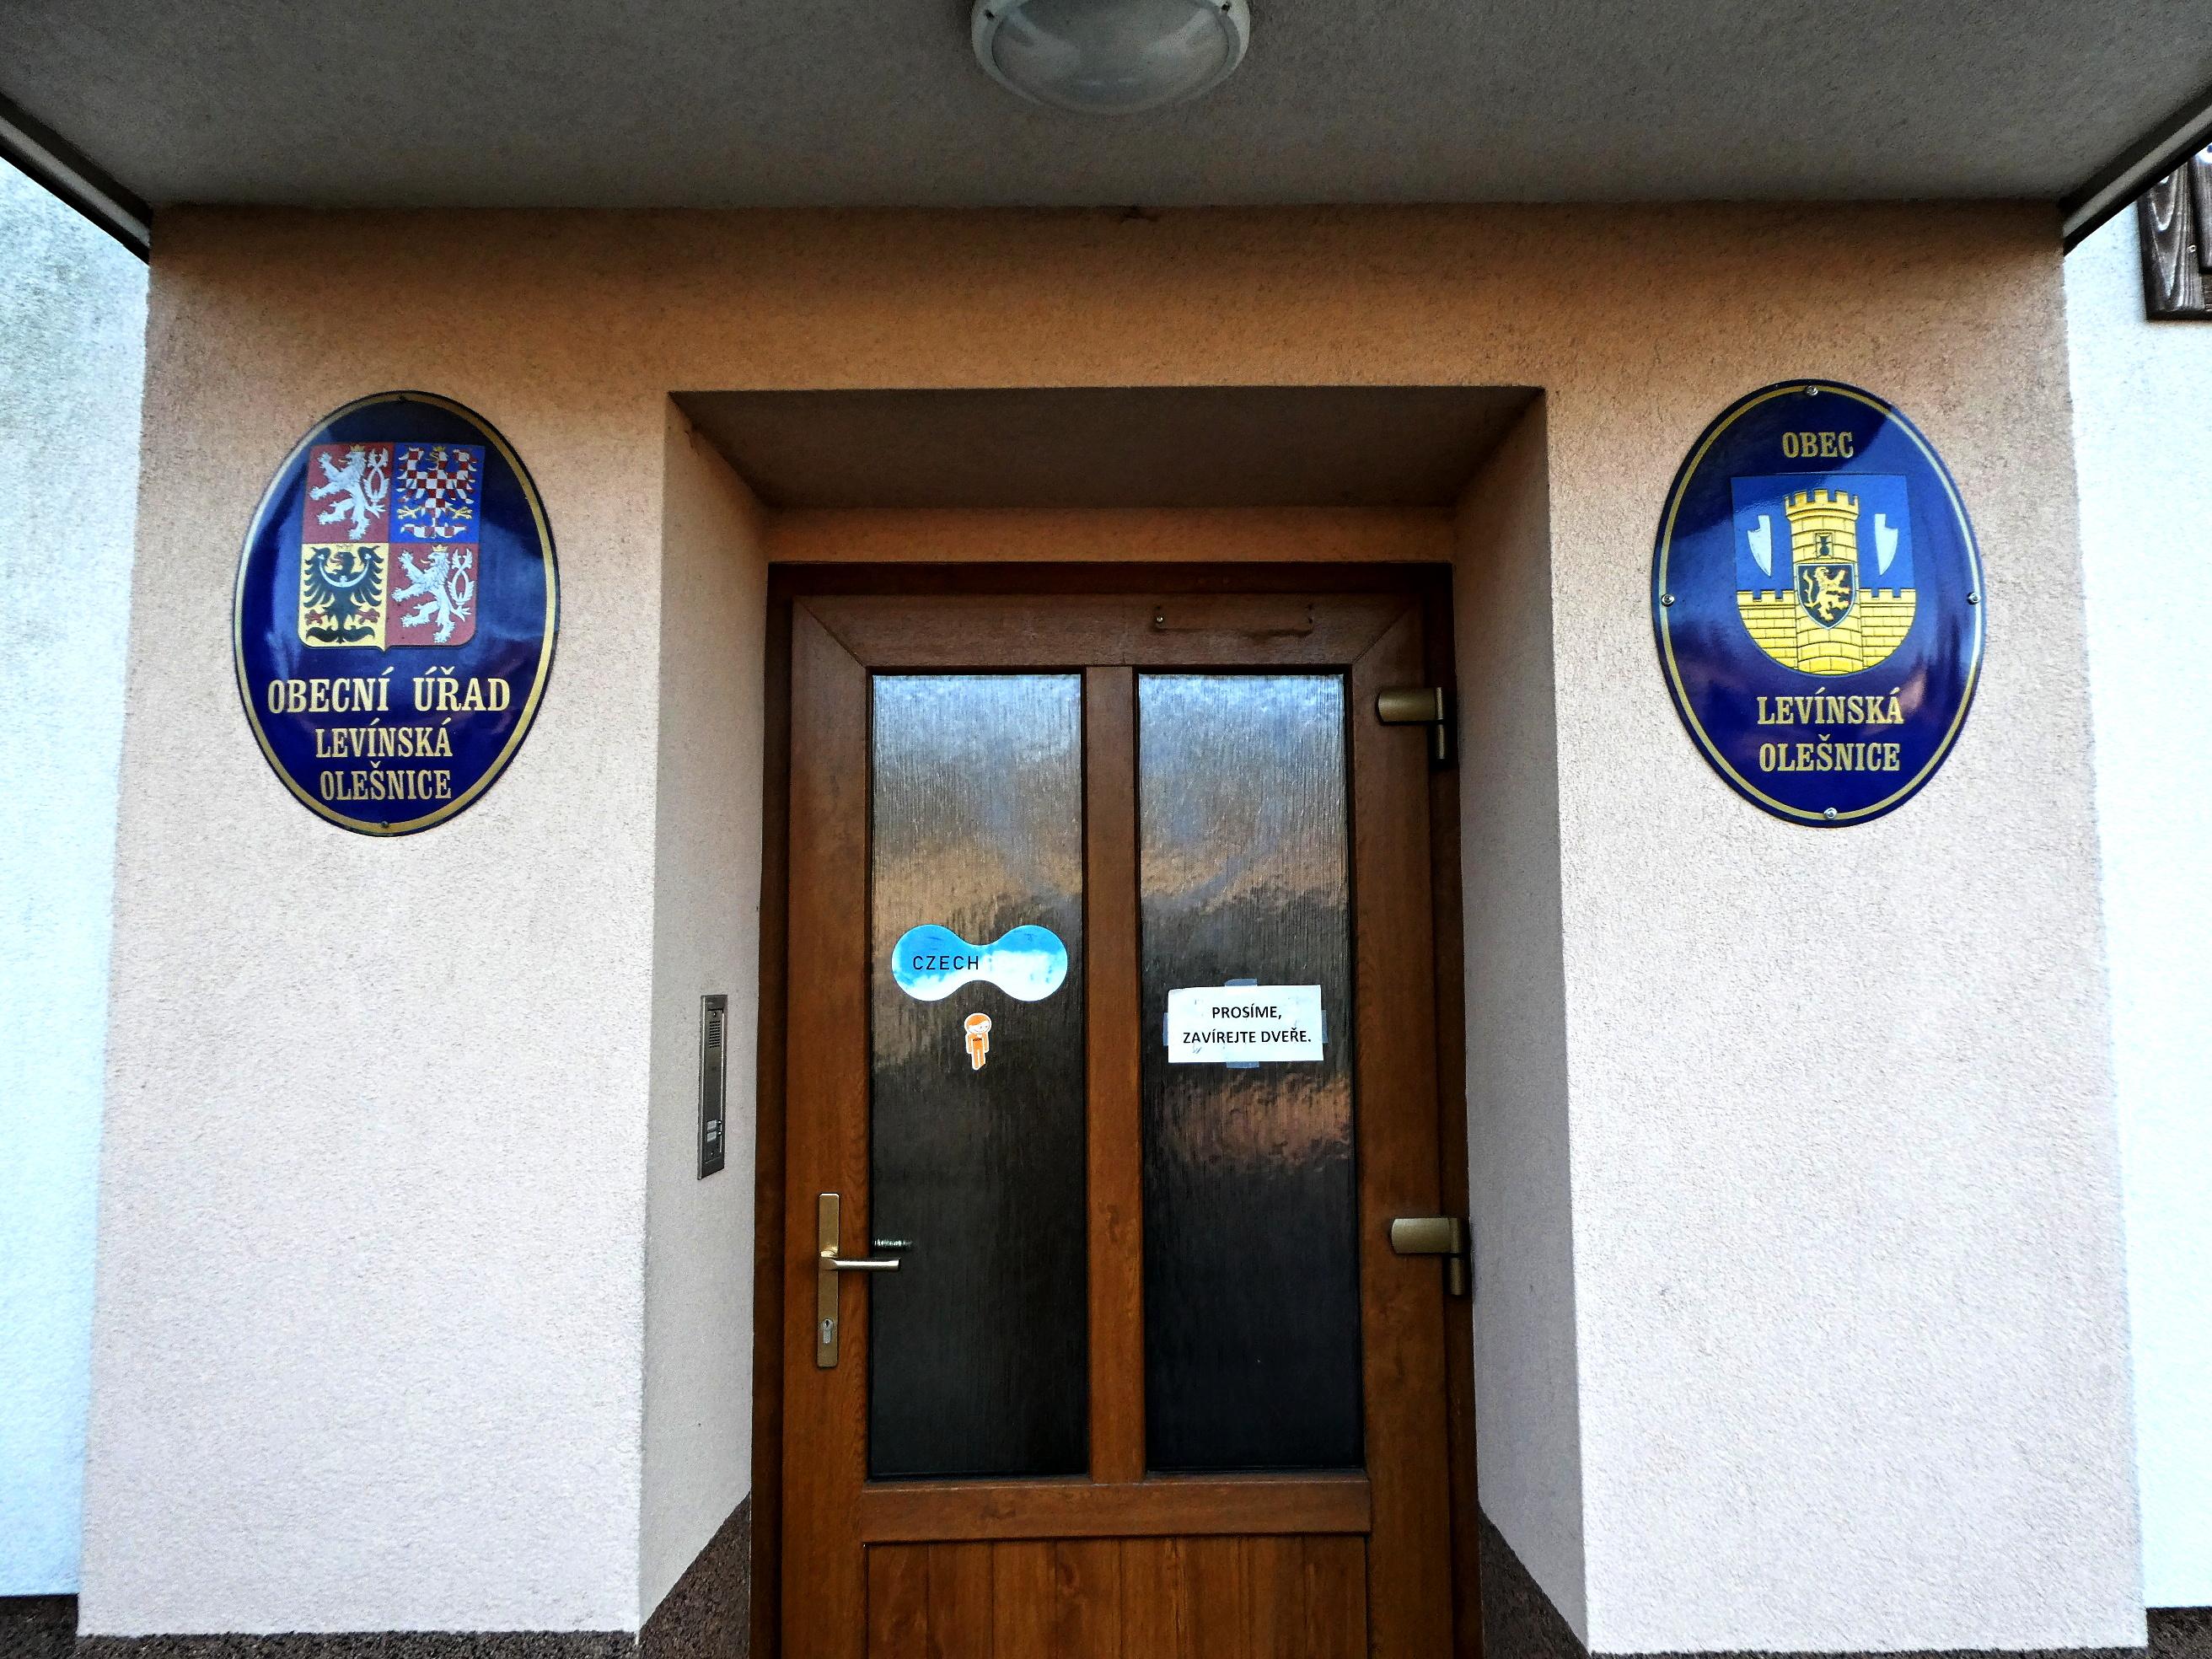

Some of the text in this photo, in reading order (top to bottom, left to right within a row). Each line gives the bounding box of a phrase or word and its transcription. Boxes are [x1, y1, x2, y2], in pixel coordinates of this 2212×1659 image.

[1781, 431, 1855, 459] OBEC
[267, 665, 511, 714] OBECNÍ ÚŘAD
[1756, 686, 1905, 726] LEVÍNSKÁ
[315, 717, 453, 759] LEVÍNSKÁ
[1758, 733, 1901, 772] OLEŠNICE
[319, 760, 452, 802] OLEŠNICE
[912, 955, 979, 970] CZECH
[1211, 1002, 1282, 1020] PROSÍME,
[1183, 1027, 1312, 1044] ZAVÍREJTE DVEŘE.
